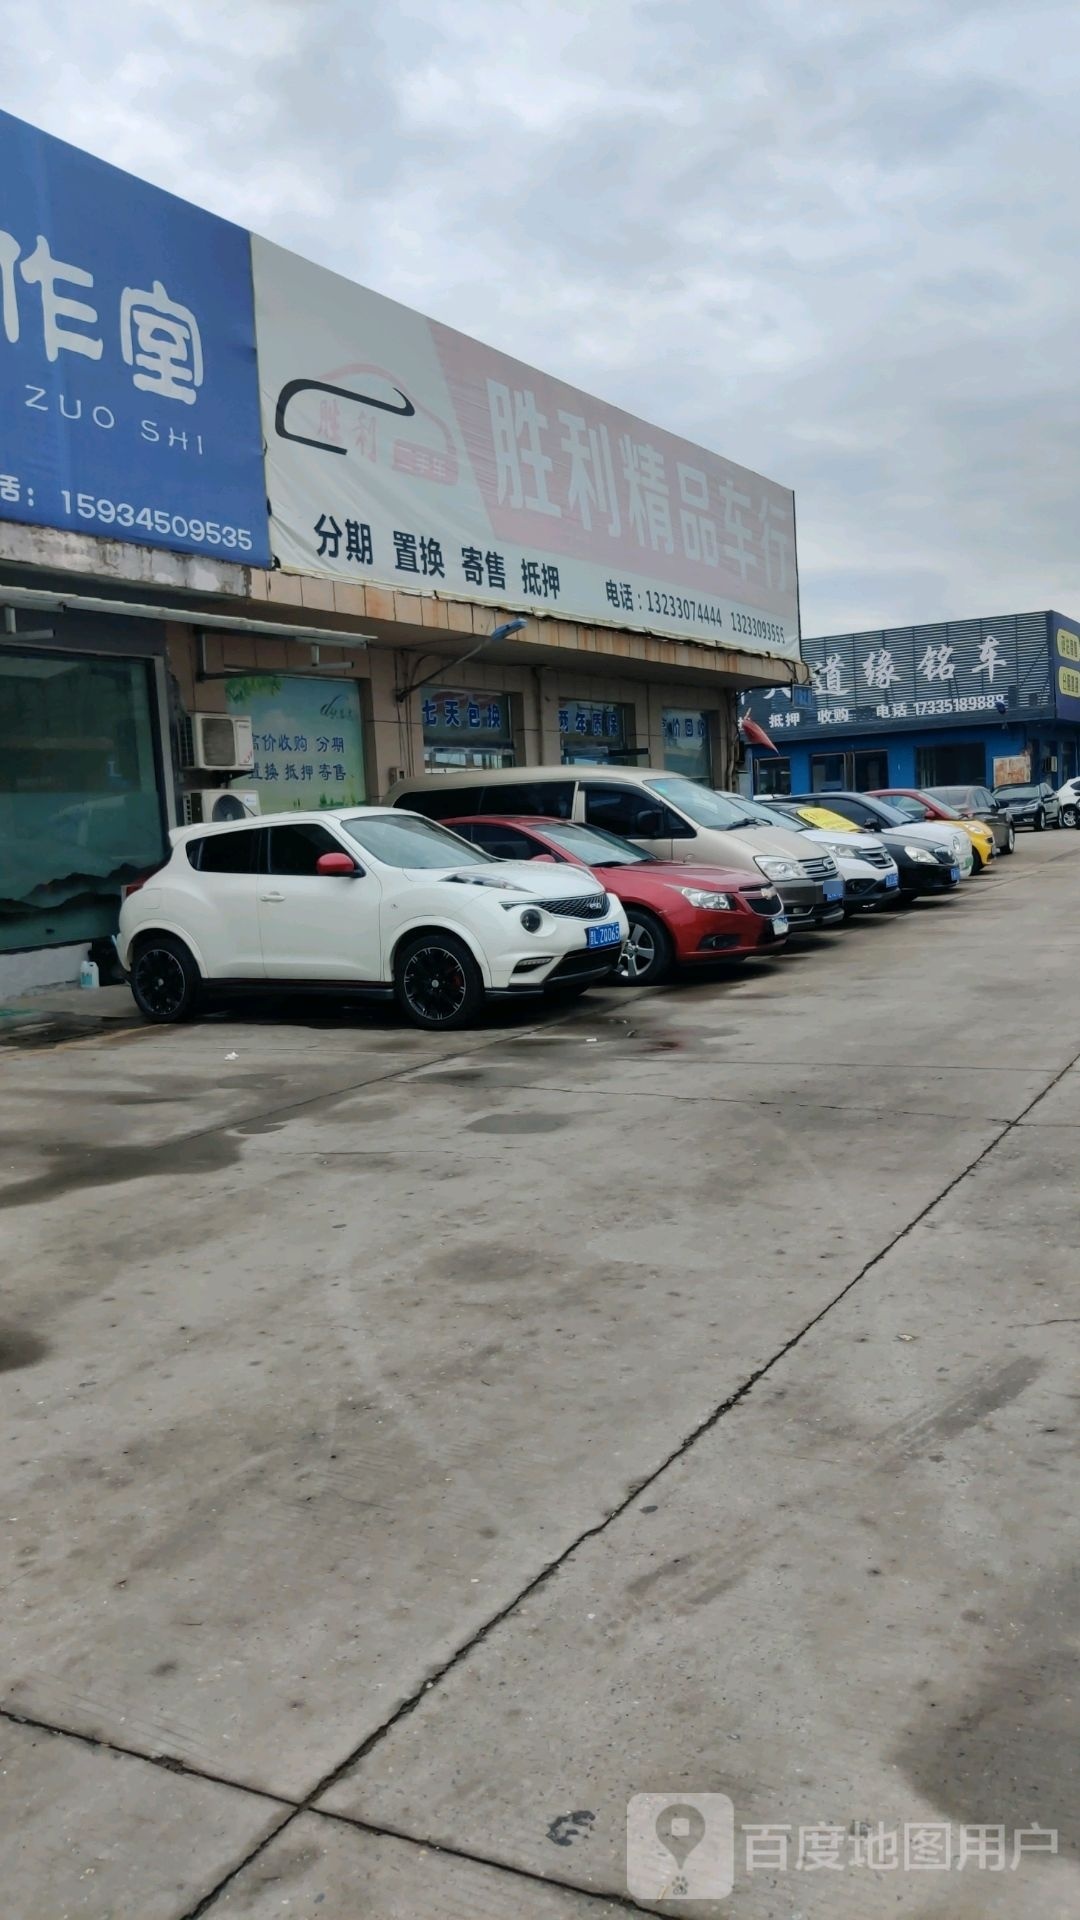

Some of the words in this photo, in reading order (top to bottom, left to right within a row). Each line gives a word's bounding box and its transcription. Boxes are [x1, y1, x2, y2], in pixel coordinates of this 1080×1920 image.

[0, 231, 204, 404] 作室
[24, 384, 116, 430] ZUO
[140, 420, 204, 455] SHI
[486, 377, 790, 594] 胜利精品车行
[61, 490, 253, 551] 15934509535
[313, 513, 374, 565] 分期
[393, 530, 446, 578] 置换
[461, 546, 506, 590] 寄售
[521, 558, 560, 599] 抵押
[730, 611, 785, 644] 13233093555
[316, 736, 344, 753] 分期
[422, 699, 501, 729] 七天包换
[769, 712, 800, 728] 抵押
[817, 709, 849, 725] 收购
[876, 704, 907, 719] 电话
[285, 763, 314, 781] 抵押
[319, 763, 346, 781] 寄售
